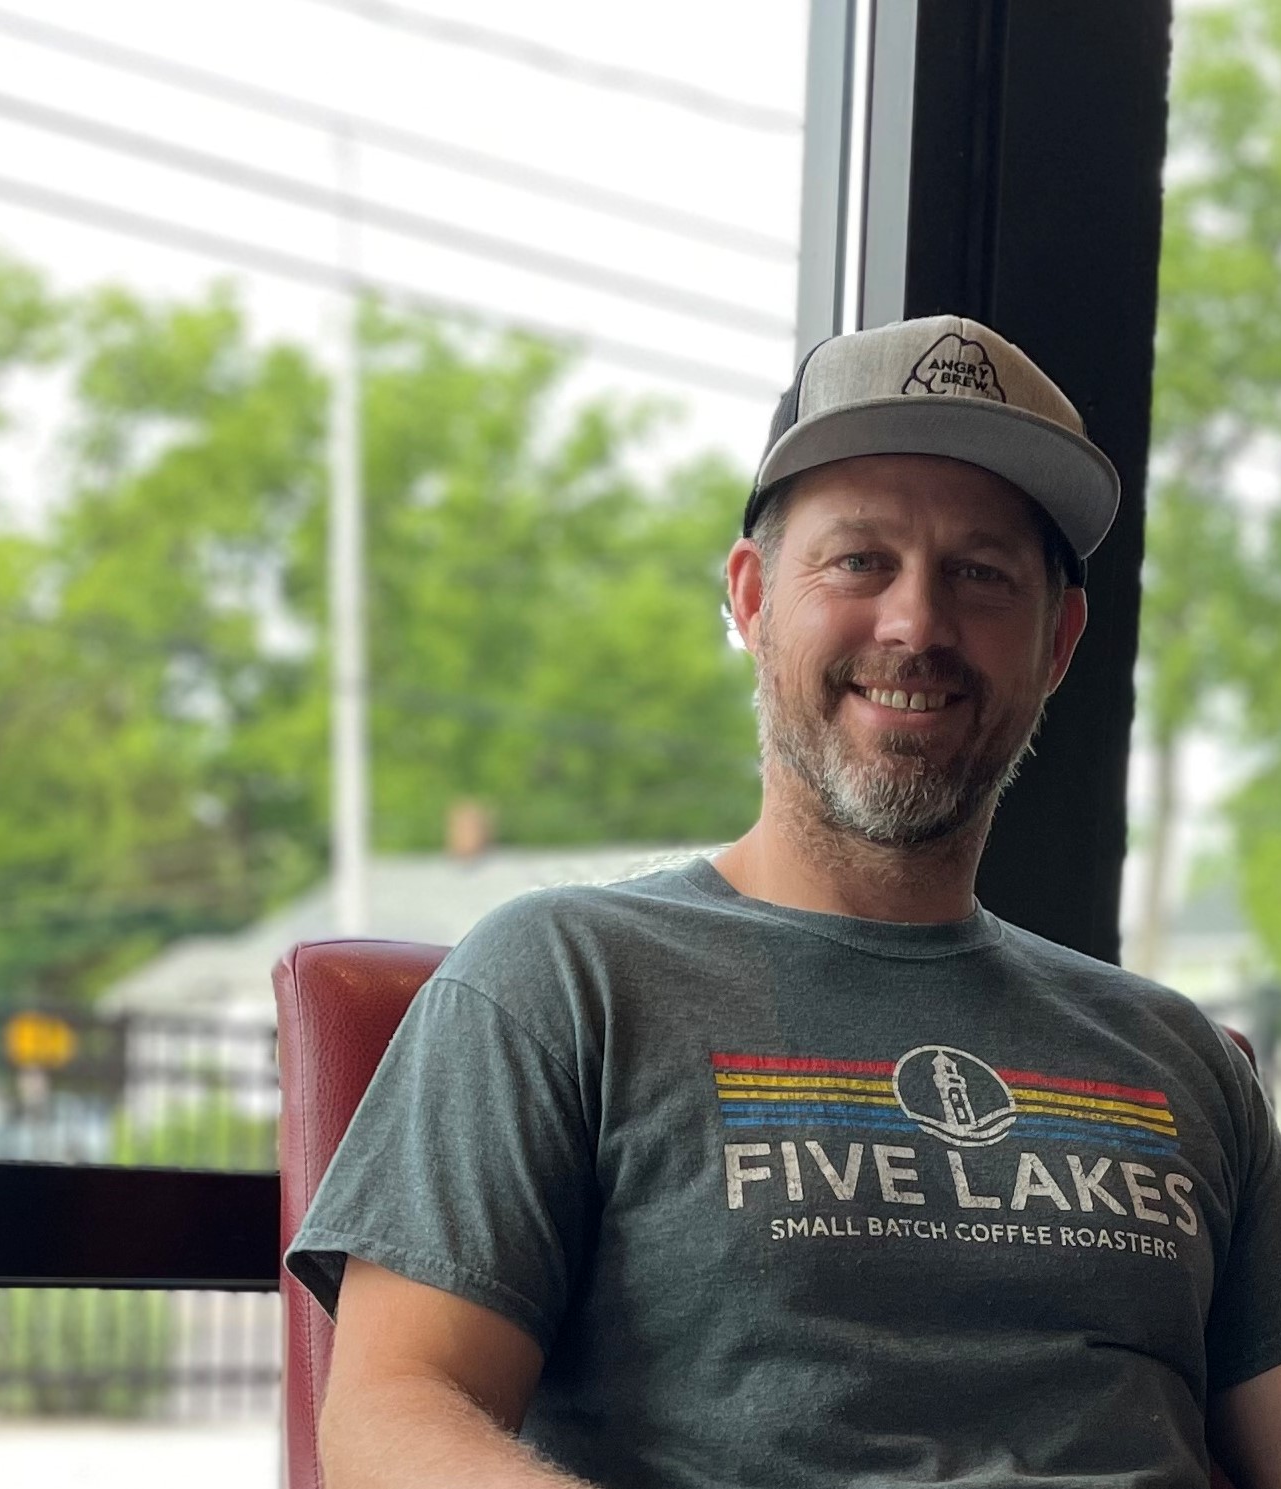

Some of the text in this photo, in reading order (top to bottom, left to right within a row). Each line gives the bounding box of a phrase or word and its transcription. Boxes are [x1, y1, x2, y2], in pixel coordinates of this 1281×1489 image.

[928, 359, 988, 379] ANGRY
[941, 372, 988, 391] BREW
[724, 1141, 1197, 1236] FIVE LAKES
[770, 1216, 1178, 1261] SMALL BATCH COFFEE ROASTERS
